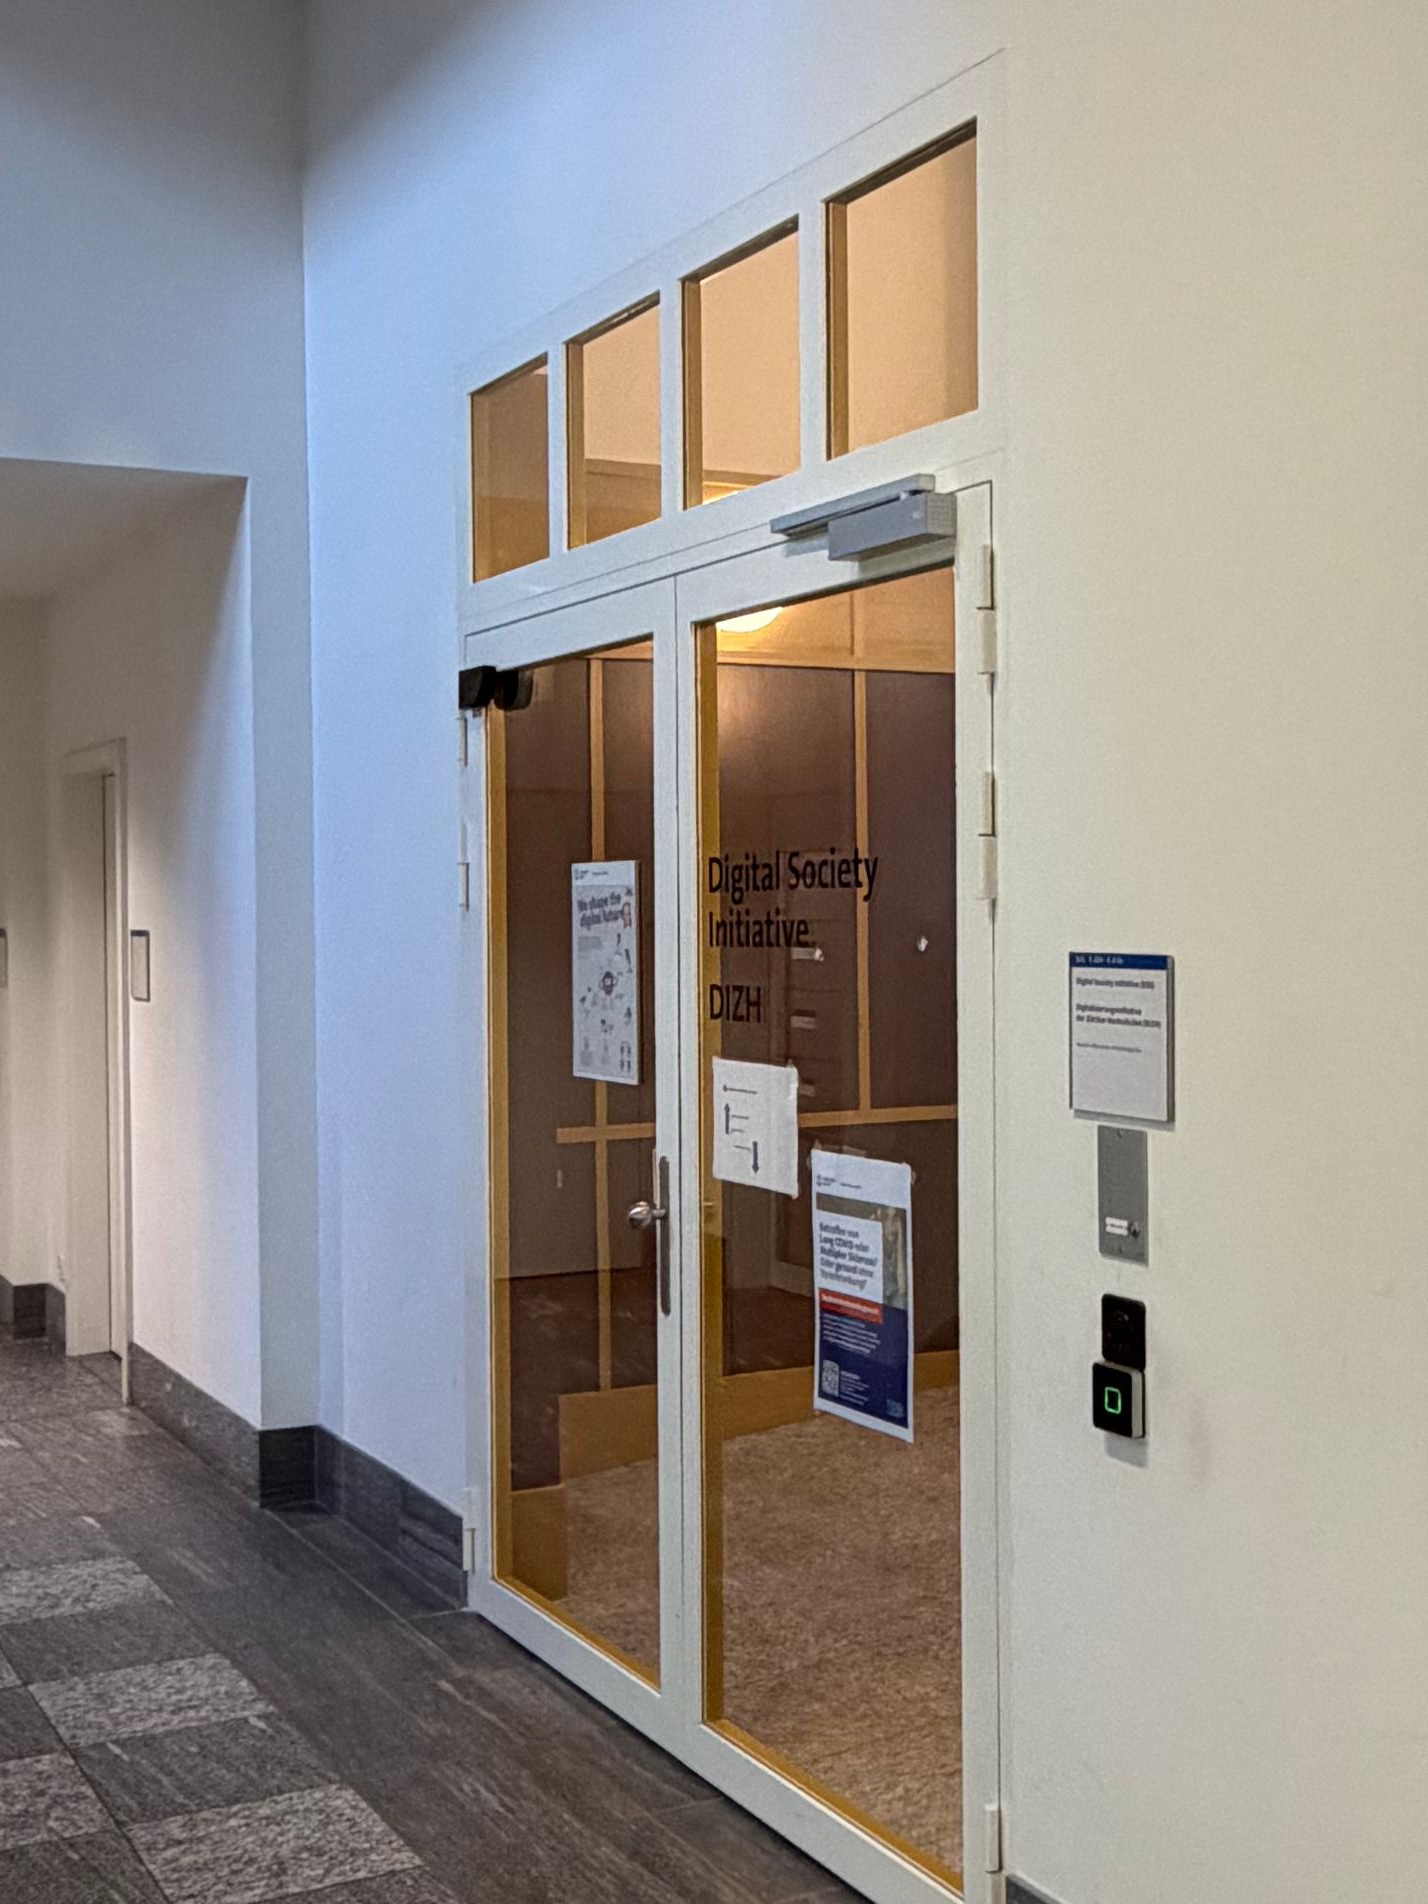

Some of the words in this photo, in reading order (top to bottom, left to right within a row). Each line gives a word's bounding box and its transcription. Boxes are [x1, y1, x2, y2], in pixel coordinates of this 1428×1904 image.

[709, 850, 780, 905] Digital
[788, 847, 878, 902] Society
[709, 907, 809, 947] Initiative
[710, 984, 761, 1023] DIZH
